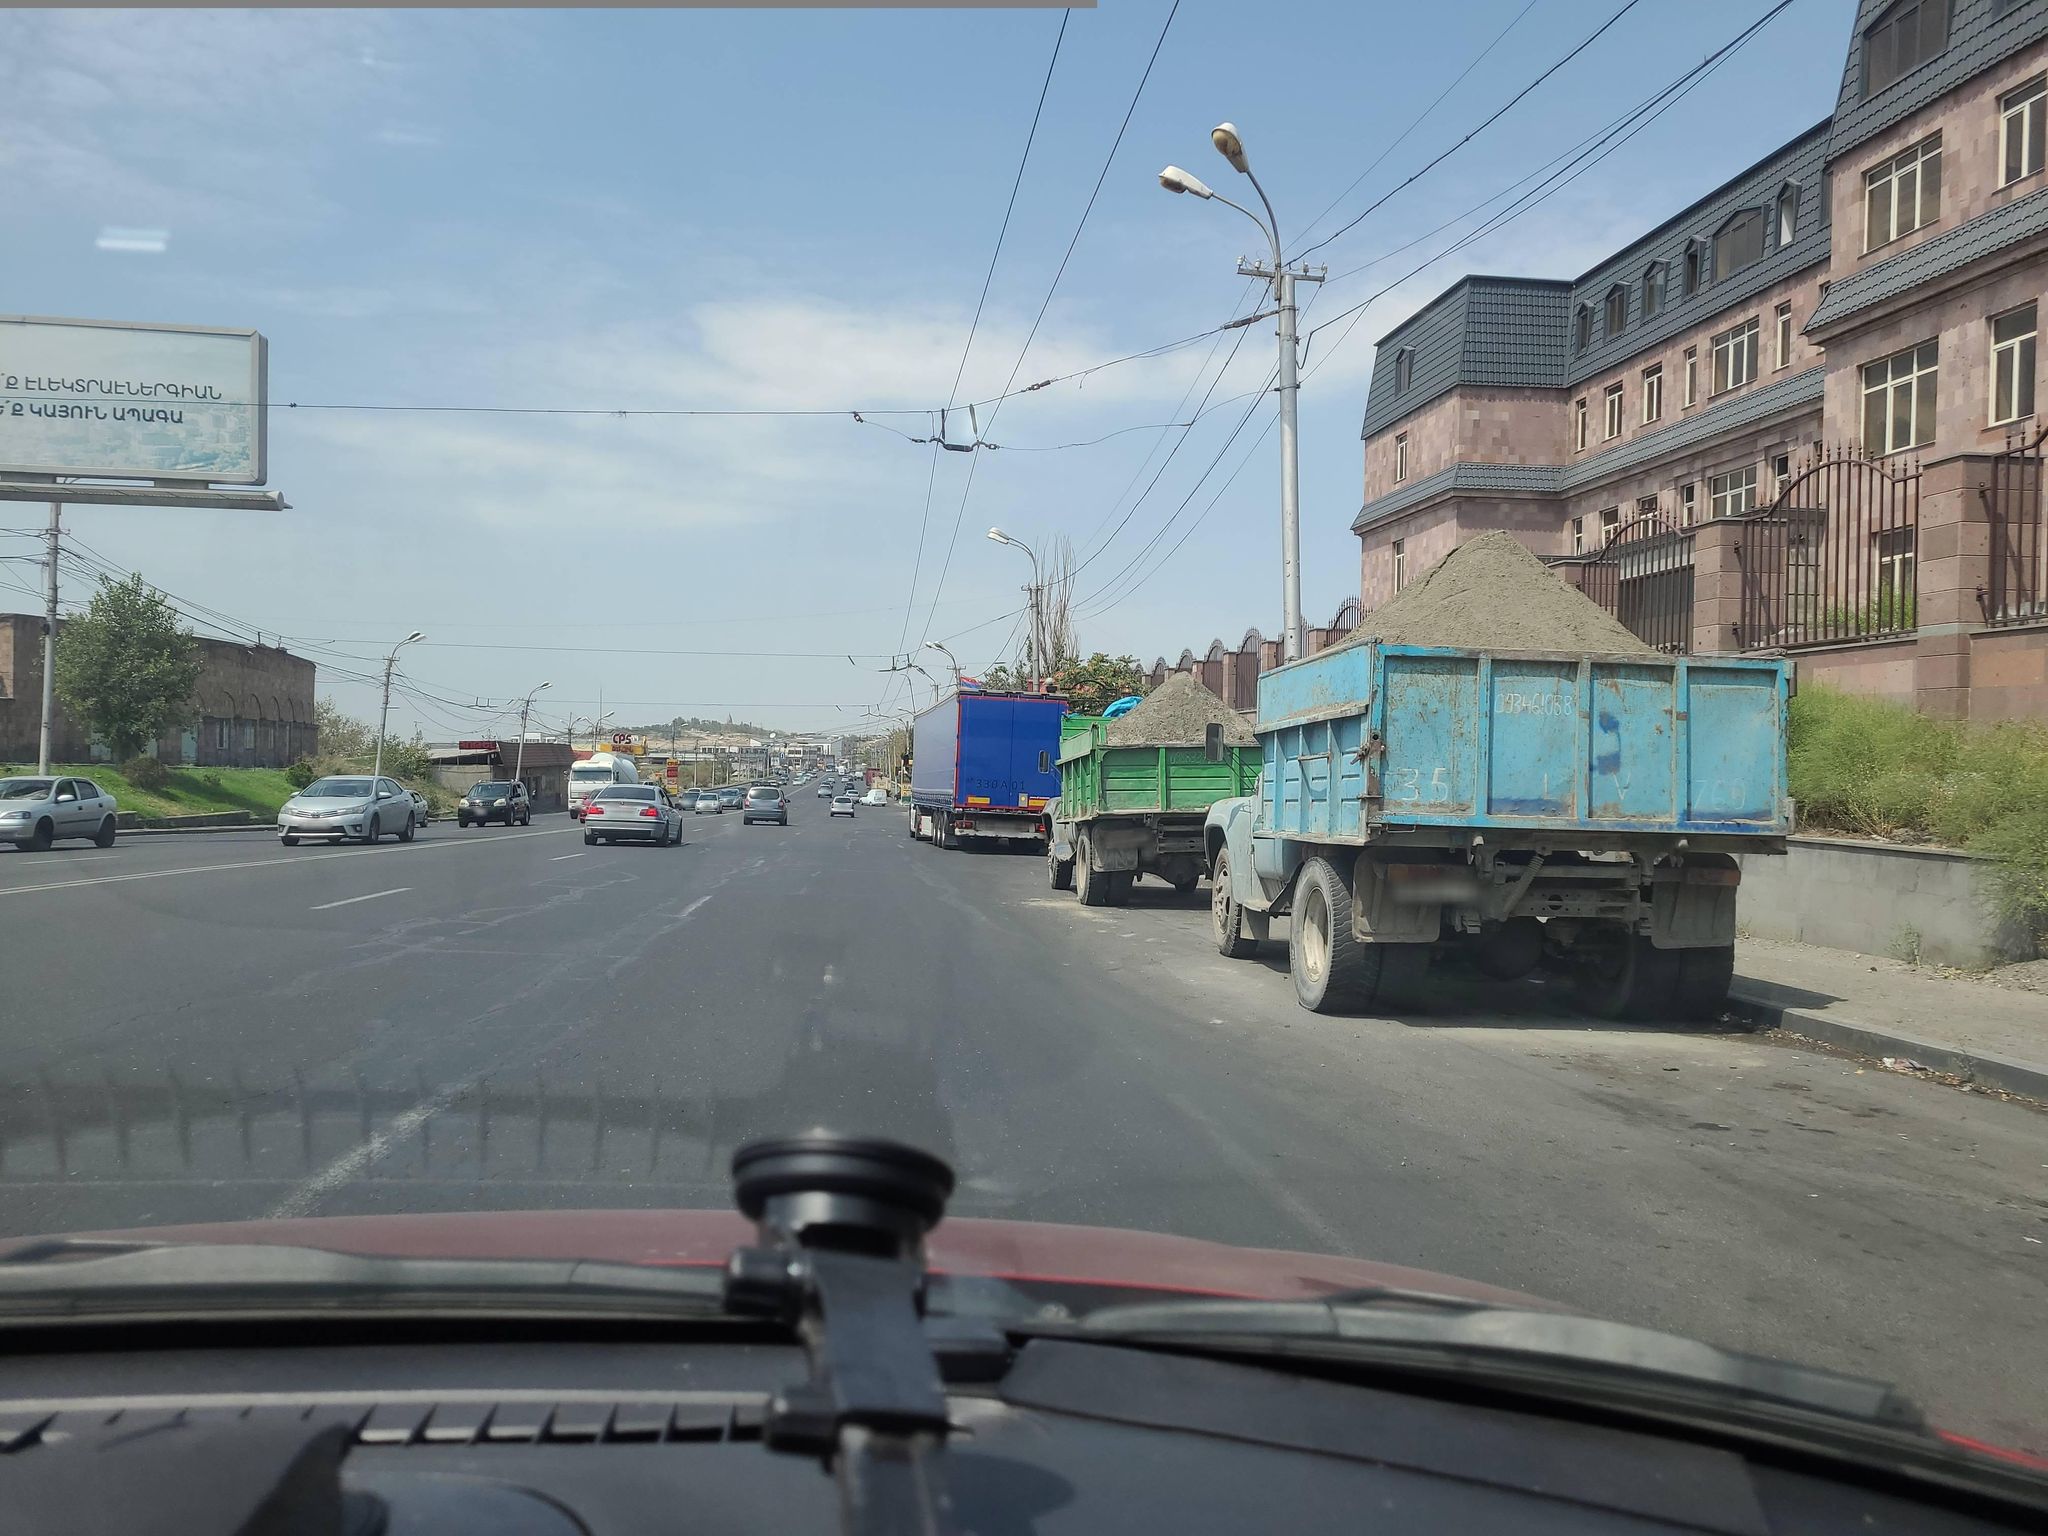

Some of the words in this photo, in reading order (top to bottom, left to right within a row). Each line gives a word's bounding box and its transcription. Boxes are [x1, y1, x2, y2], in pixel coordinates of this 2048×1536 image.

[25, 376, 222, 400] ԷԼԵԿՏՐԱԷՆԵՐԳԻԱՆ
[30, 403, 107, 420] ԿԱՅՈՒՆ
[113, 407, 183, 424] ԱՊԱԳԱ
[612, 733, 632, 745] CPS
